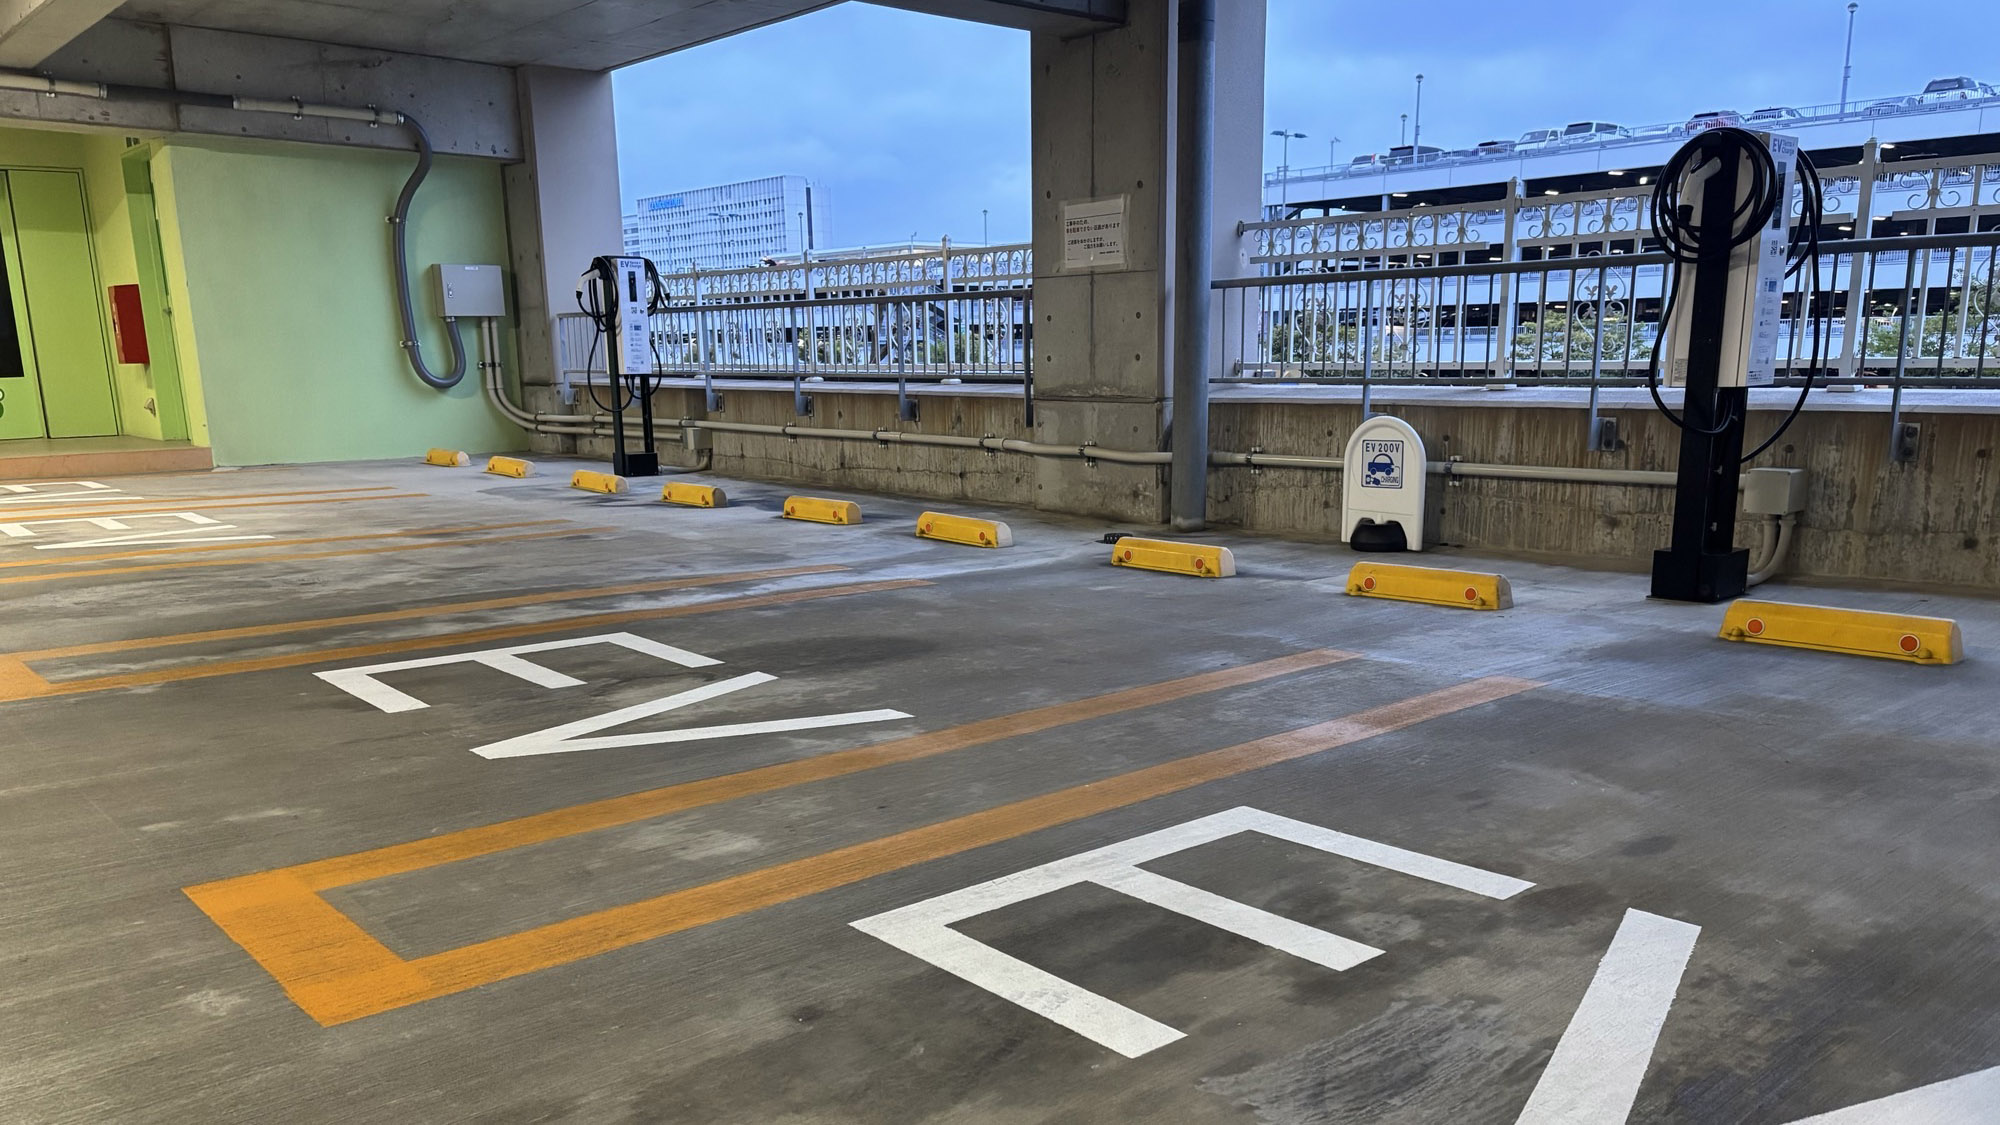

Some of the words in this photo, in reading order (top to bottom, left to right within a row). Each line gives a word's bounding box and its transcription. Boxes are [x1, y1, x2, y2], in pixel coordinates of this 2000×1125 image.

[1772, 138, 1783, 153] EV
[1782, 147, 1795, 156] Charge
[1365, 443, 1376, 453] EV
[1378, 443, 1400, 453] 200V
[1380, 476, 1399, 484] CHARGING
[0, 511, 276, 549] EV
[312, 632, 916, 760] EV
